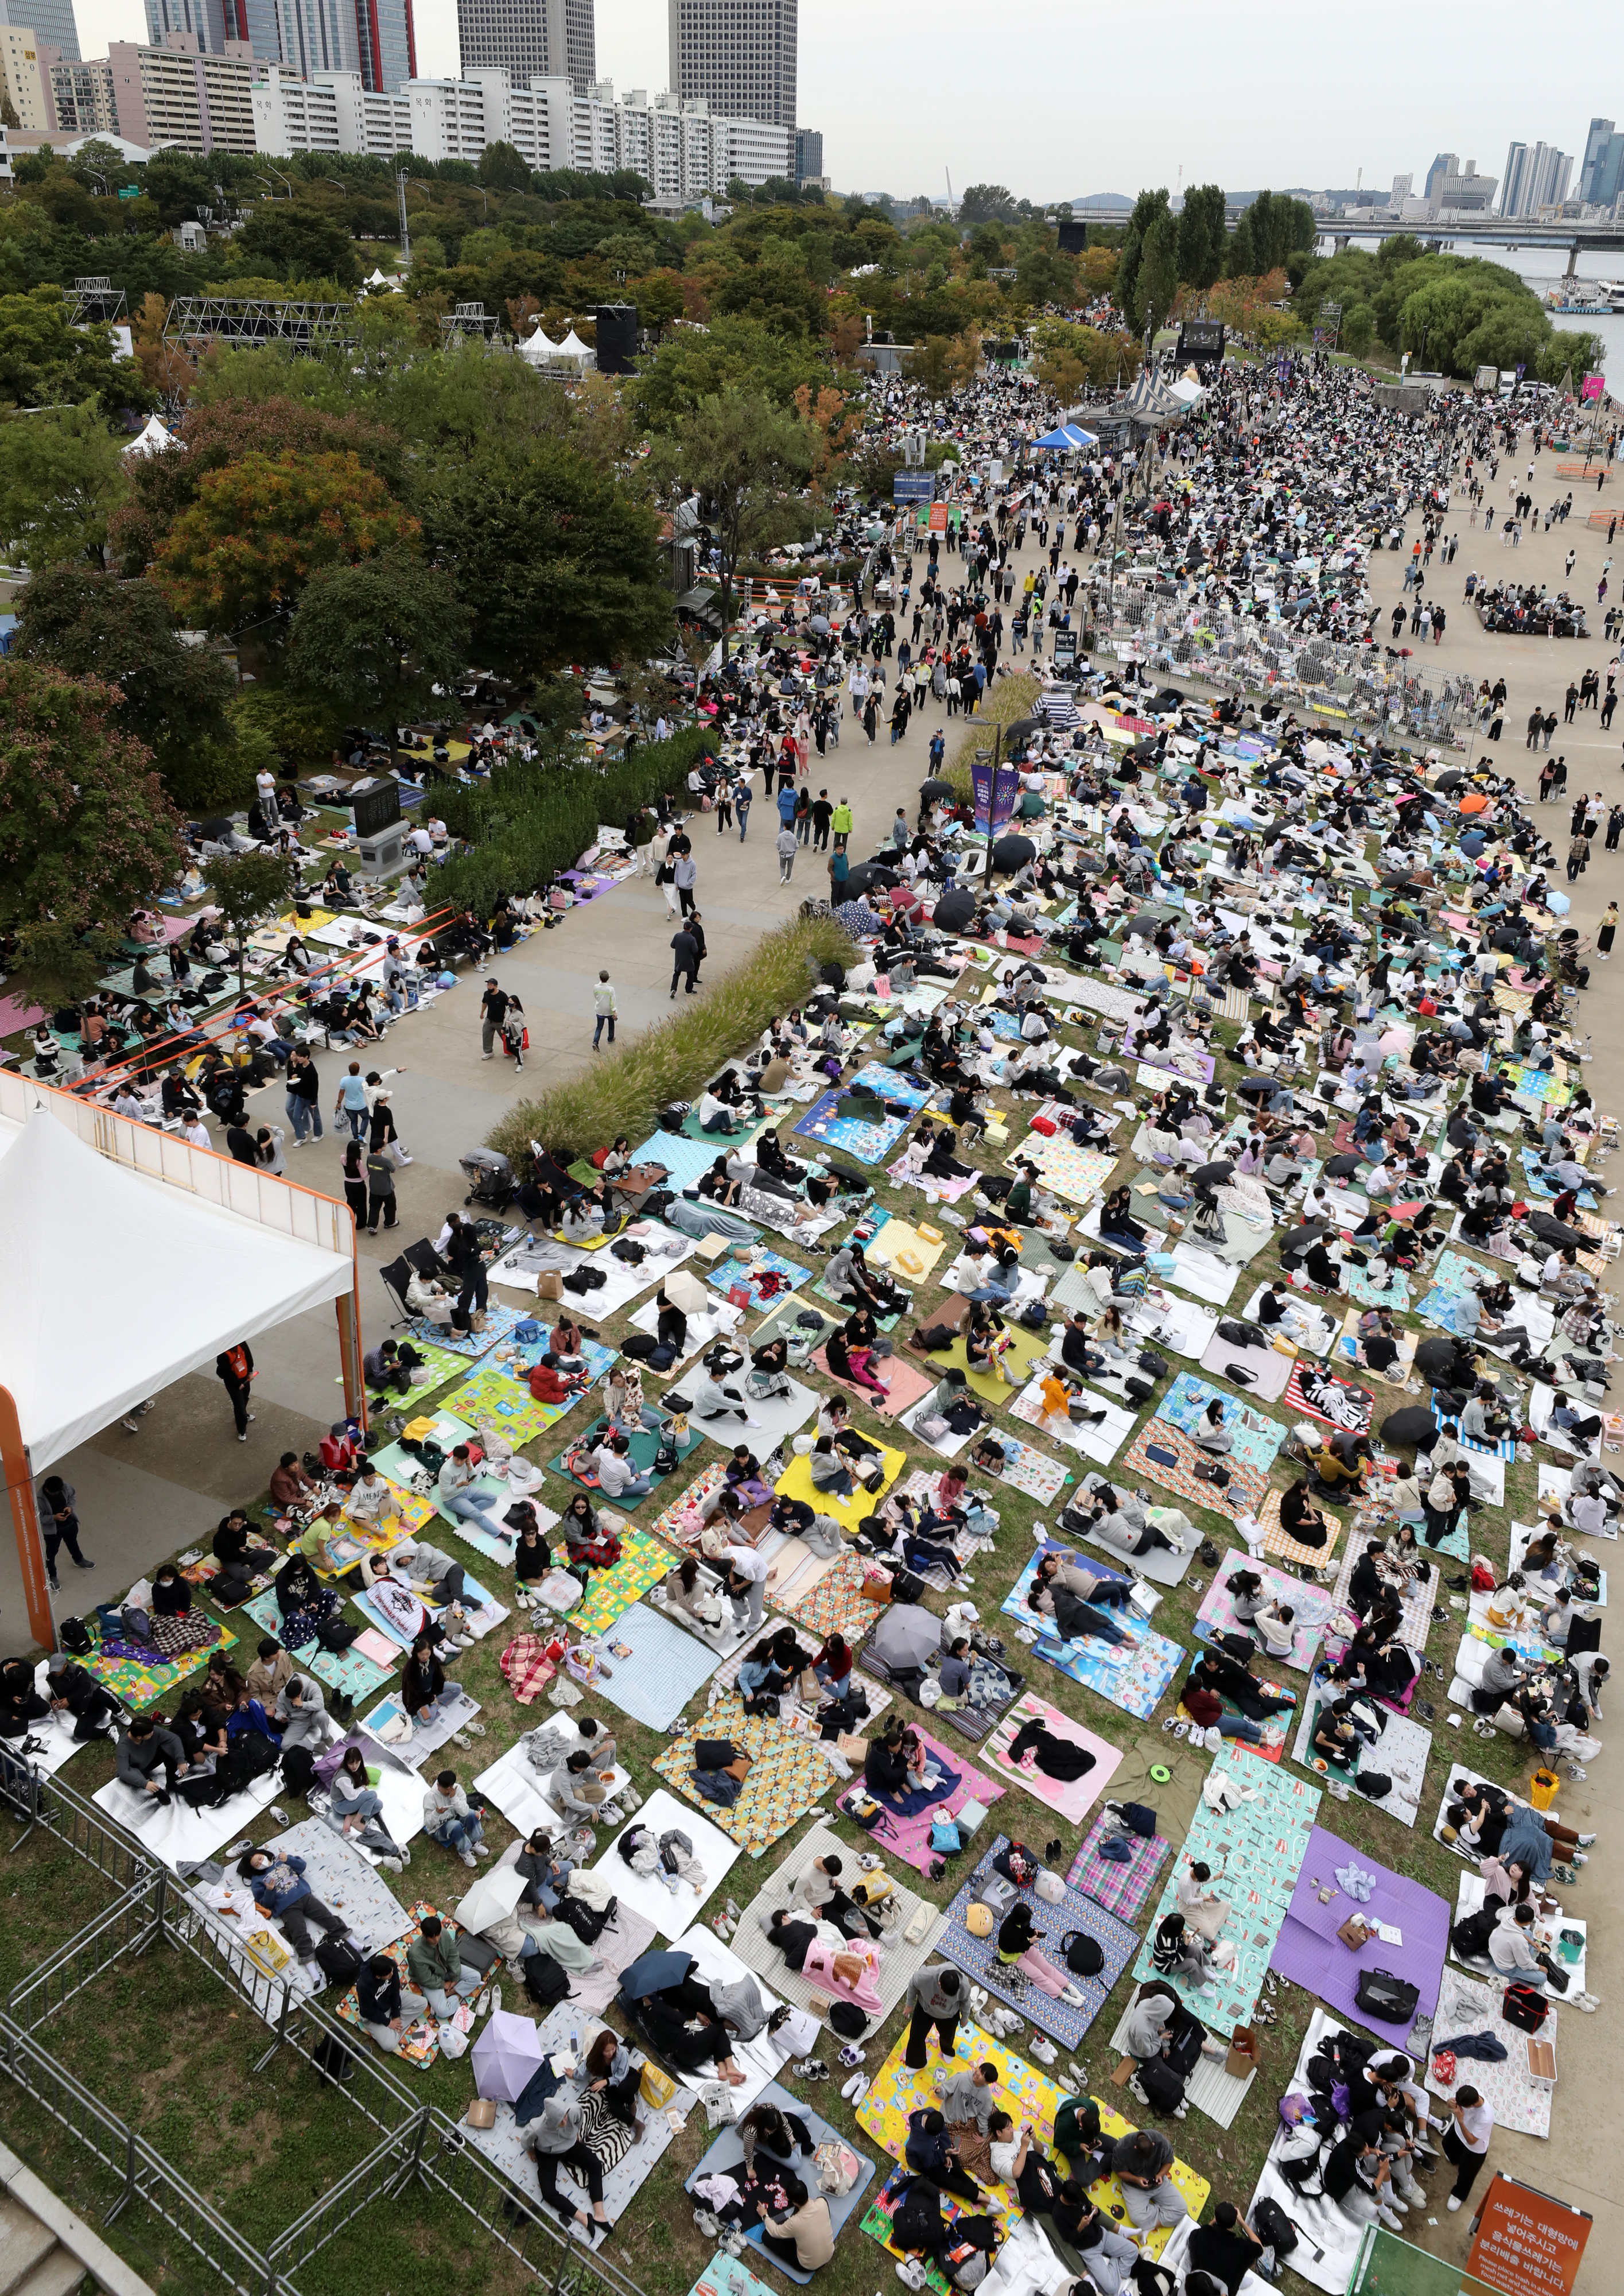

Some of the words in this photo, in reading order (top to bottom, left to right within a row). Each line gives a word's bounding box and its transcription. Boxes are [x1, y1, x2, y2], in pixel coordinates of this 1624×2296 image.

[25, 51, 36, 60] 삼부
[256, 100, 271, 110] 목화
[415, 98, 432, 107] 목화
[19, 1508, 31, 1554] INTERNATIONAL
[28, 1555, 36, 1588] FIREWORKS
[273, 1953, 285, 1967] SAVE
[376, 1979, 391, 1994] NIKE
[1493, 2202, 1534, 2228] 쓰레기는
[1537, 2223, 1579, 2251] 대형망에
[1507, 2222, 1556, 2255] 넣어주시고
[1491, 2231, 1563, 2274] 음식물쓰레기는
[1479, 2239, 1520, 2267] 분리배출
[1523, 2261, 1565, 2292] 바랍니다.
[1479, 2254, 1497, 2268] Please
[1498, 2266, 1514, 2276] place
[1515, 2274, 1530, 2285] trash
[1530, 2281, 1536, 2289] in
[1480, 2263, 1497, 2275] mesh
[1497, 2272, 1508, 2281] net
[1508, 2278, 1521, 2288] and
[1481, 2270, 1495, 2282] food
[1496, 2278, 1514, 2291] waste
